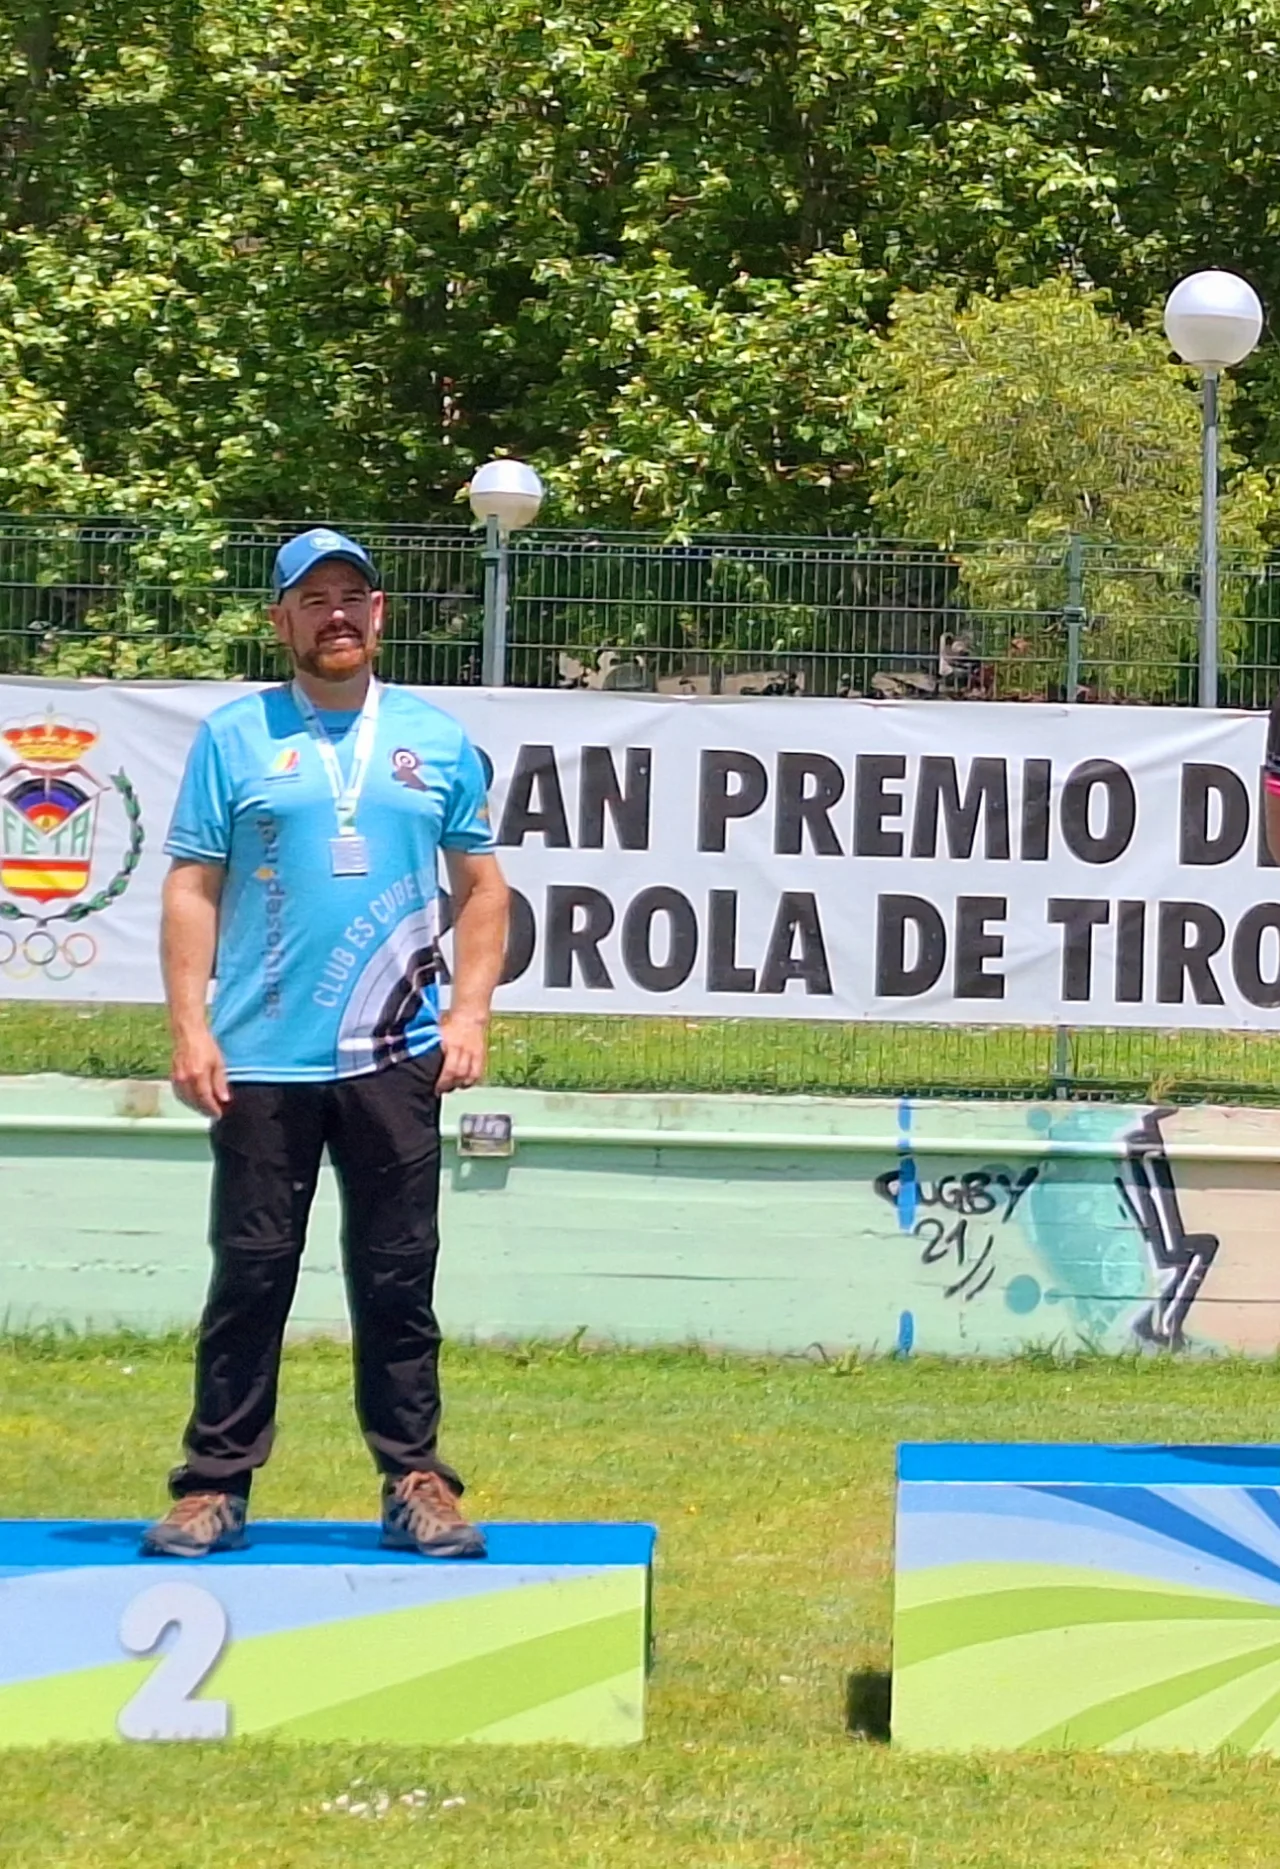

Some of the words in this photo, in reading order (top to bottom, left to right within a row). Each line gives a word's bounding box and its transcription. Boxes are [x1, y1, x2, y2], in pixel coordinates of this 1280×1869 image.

[3, 805, 92, 856] FETA
[473, 744, 653, 851] AN
[698, 749, 1136, 864] PREMIO
[312, 947, 356, 1007] CLUB
[344, 916, 376, 950] ES
[439, 885, 833, 996] DROLA
[875, 894, 1007, 998] DE
[117, 1582, 231, 1741] 2
